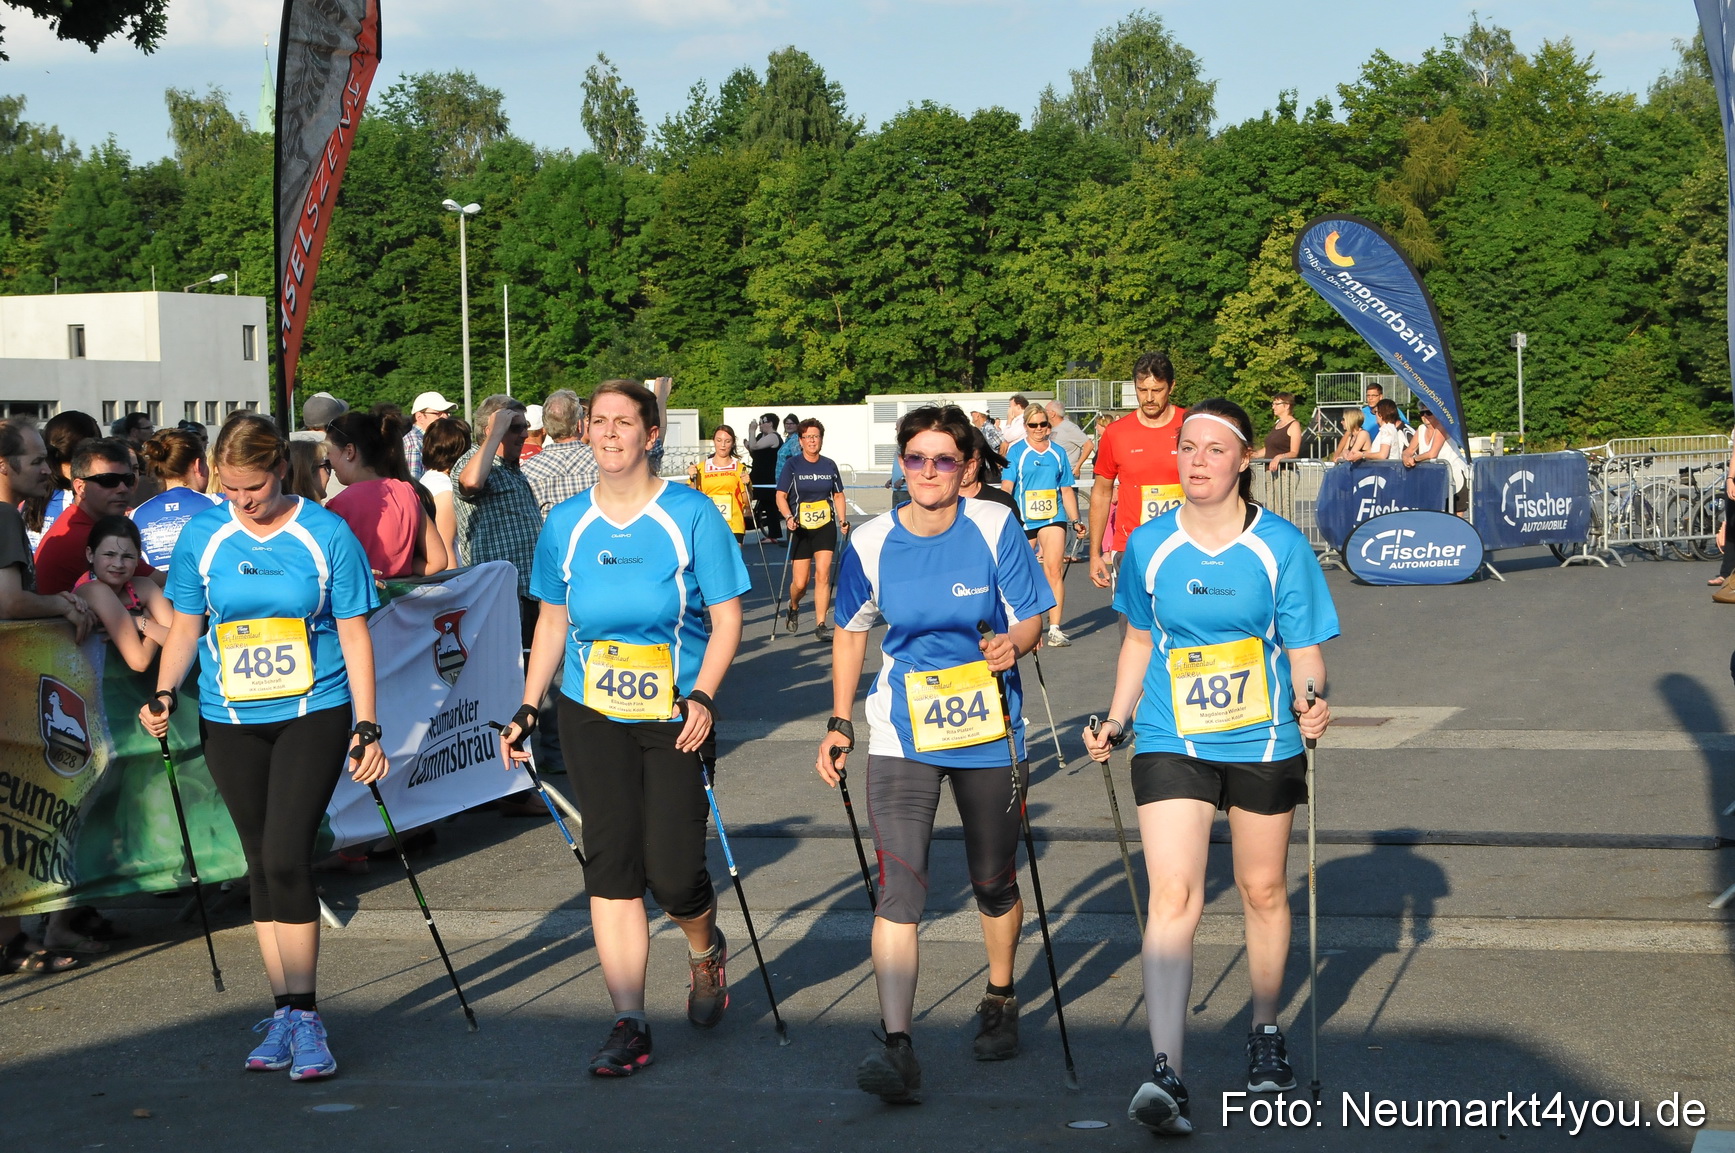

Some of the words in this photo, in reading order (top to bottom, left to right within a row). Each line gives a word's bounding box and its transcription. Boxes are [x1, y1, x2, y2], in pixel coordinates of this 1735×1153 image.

[1030, 500, 1052, 512] 483
[1356, 498, 1419, 522] Fisch
[1515, 492, 1572, 518] Fischer
[804, 510, 826, 522] 354
[1520, 520, 1568, 533] AUTOMOBILE
[618, 556, 643, 564] classic
[1380, 542, 1466, 560] Fischer
[1388, 559, 1460, 570] AUTOMOBILE
[1208, 588, 1236, 596] classic
[233, 644, 296, 678] 485
[596, 669, 659, 700] 486
[1186, 670, 1250, 710] 487
[924, 690, 990, 728] 484
[1228, 706, 1247, 715] Winkler
[426, 698, 479, 742] Neumarkter
[54, 748, 78, 768] 1628
